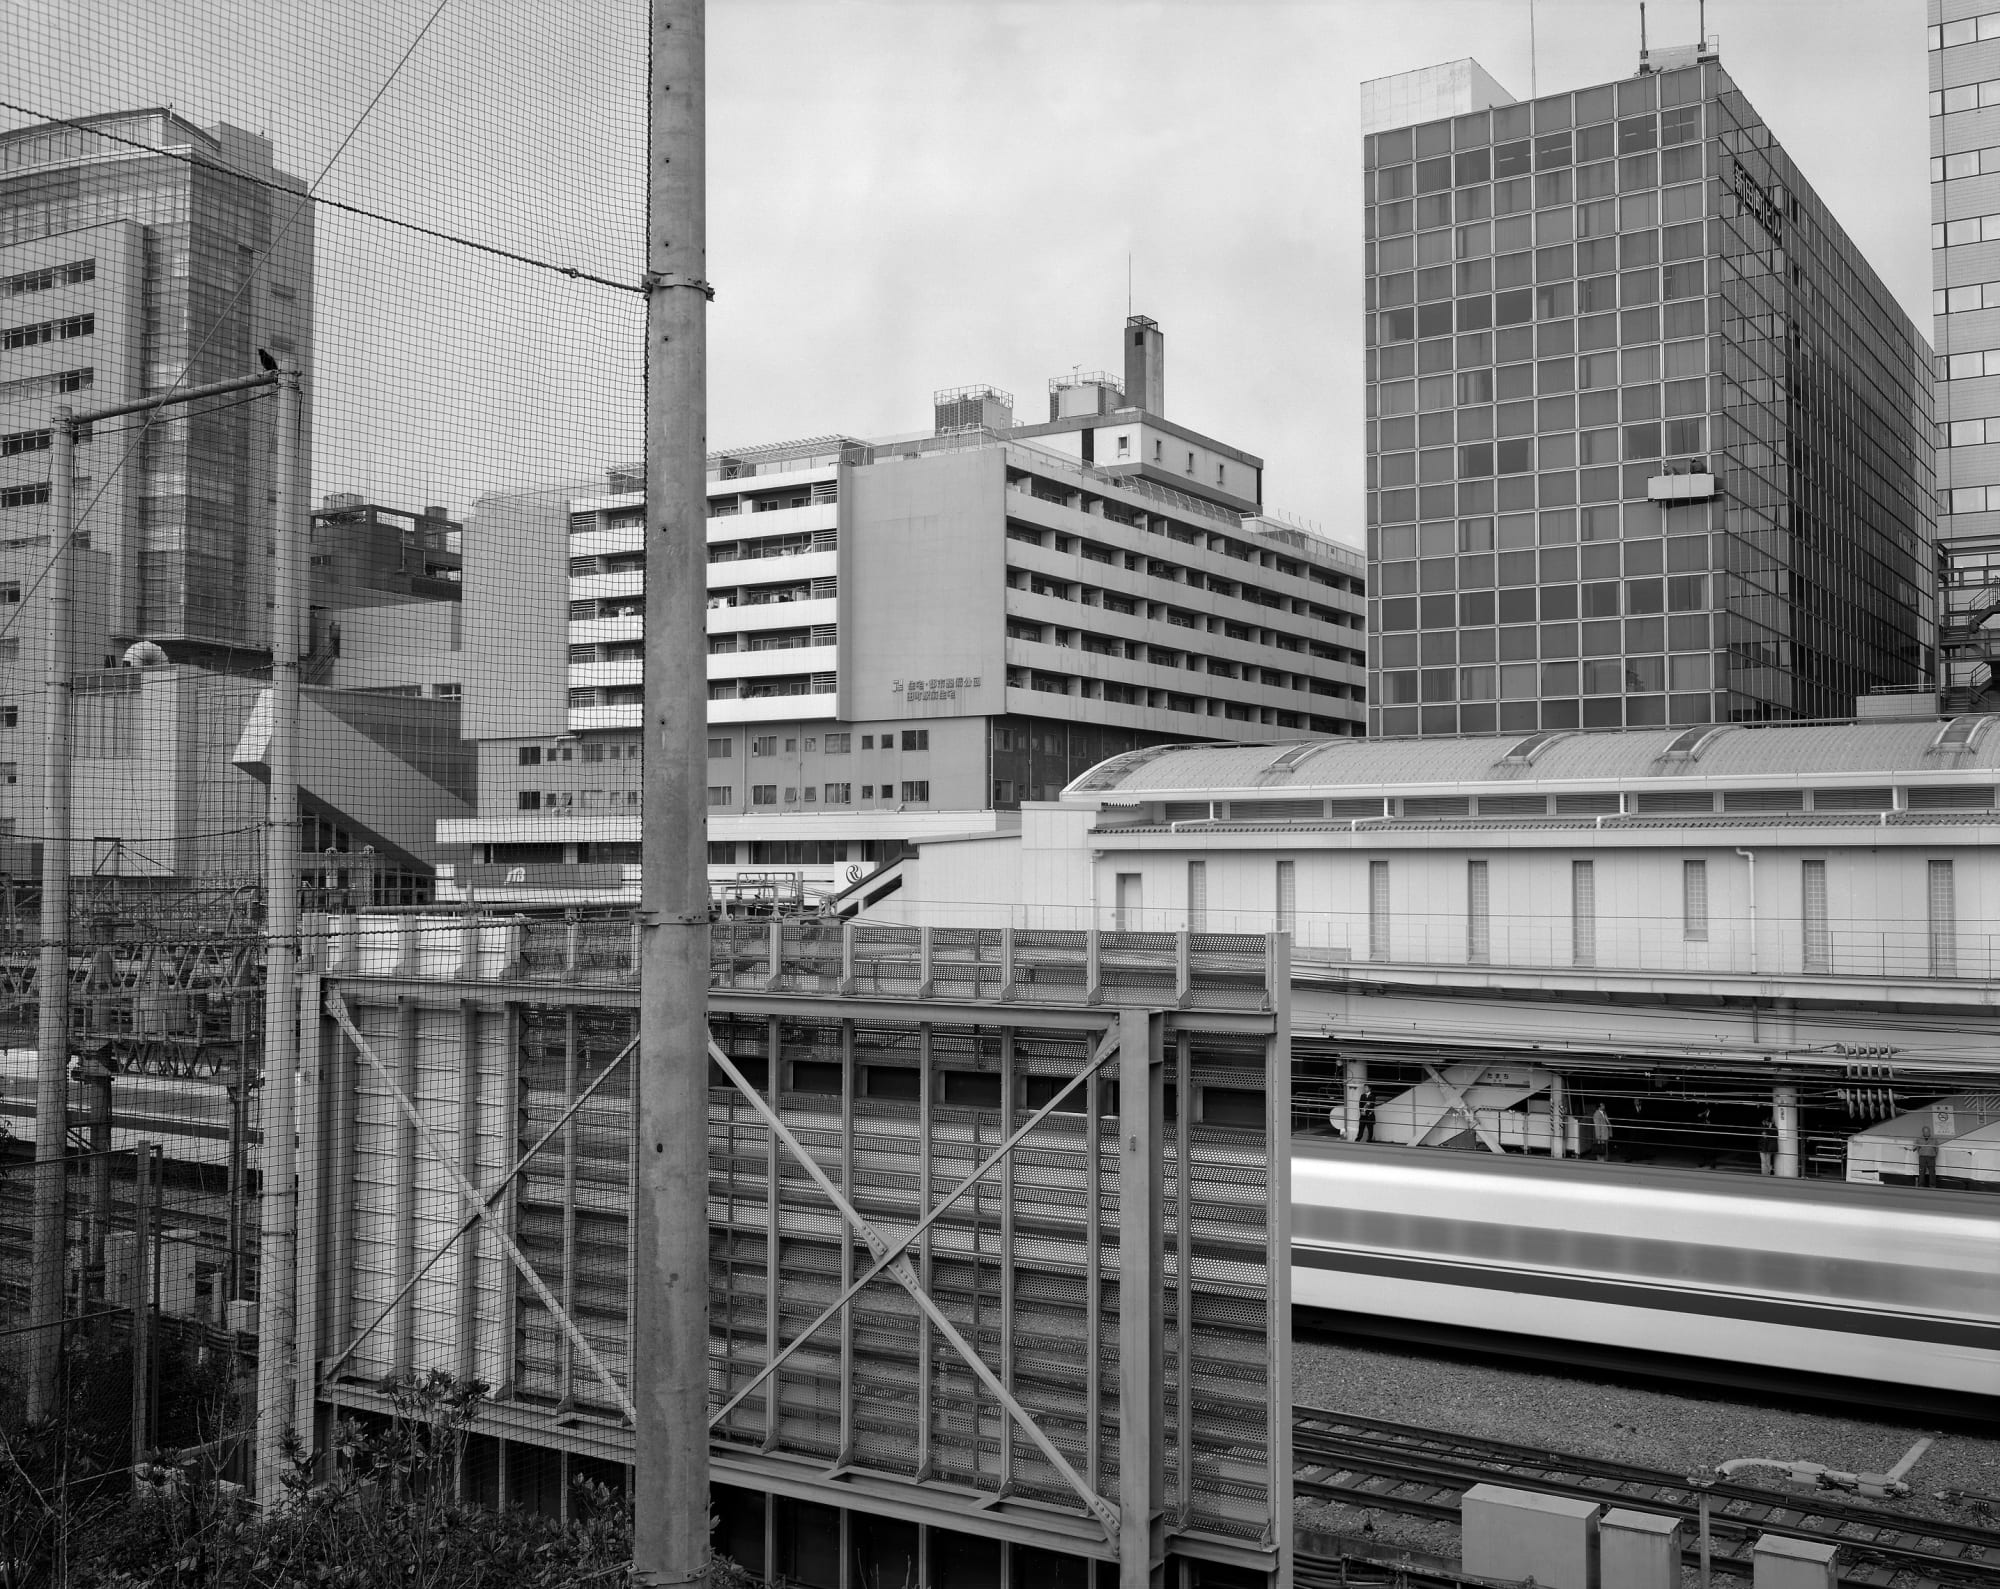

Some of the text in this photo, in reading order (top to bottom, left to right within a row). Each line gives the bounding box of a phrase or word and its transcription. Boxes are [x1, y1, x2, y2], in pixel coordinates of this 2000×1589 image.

[1735, 161, 1782, 239] 新田町ビル
